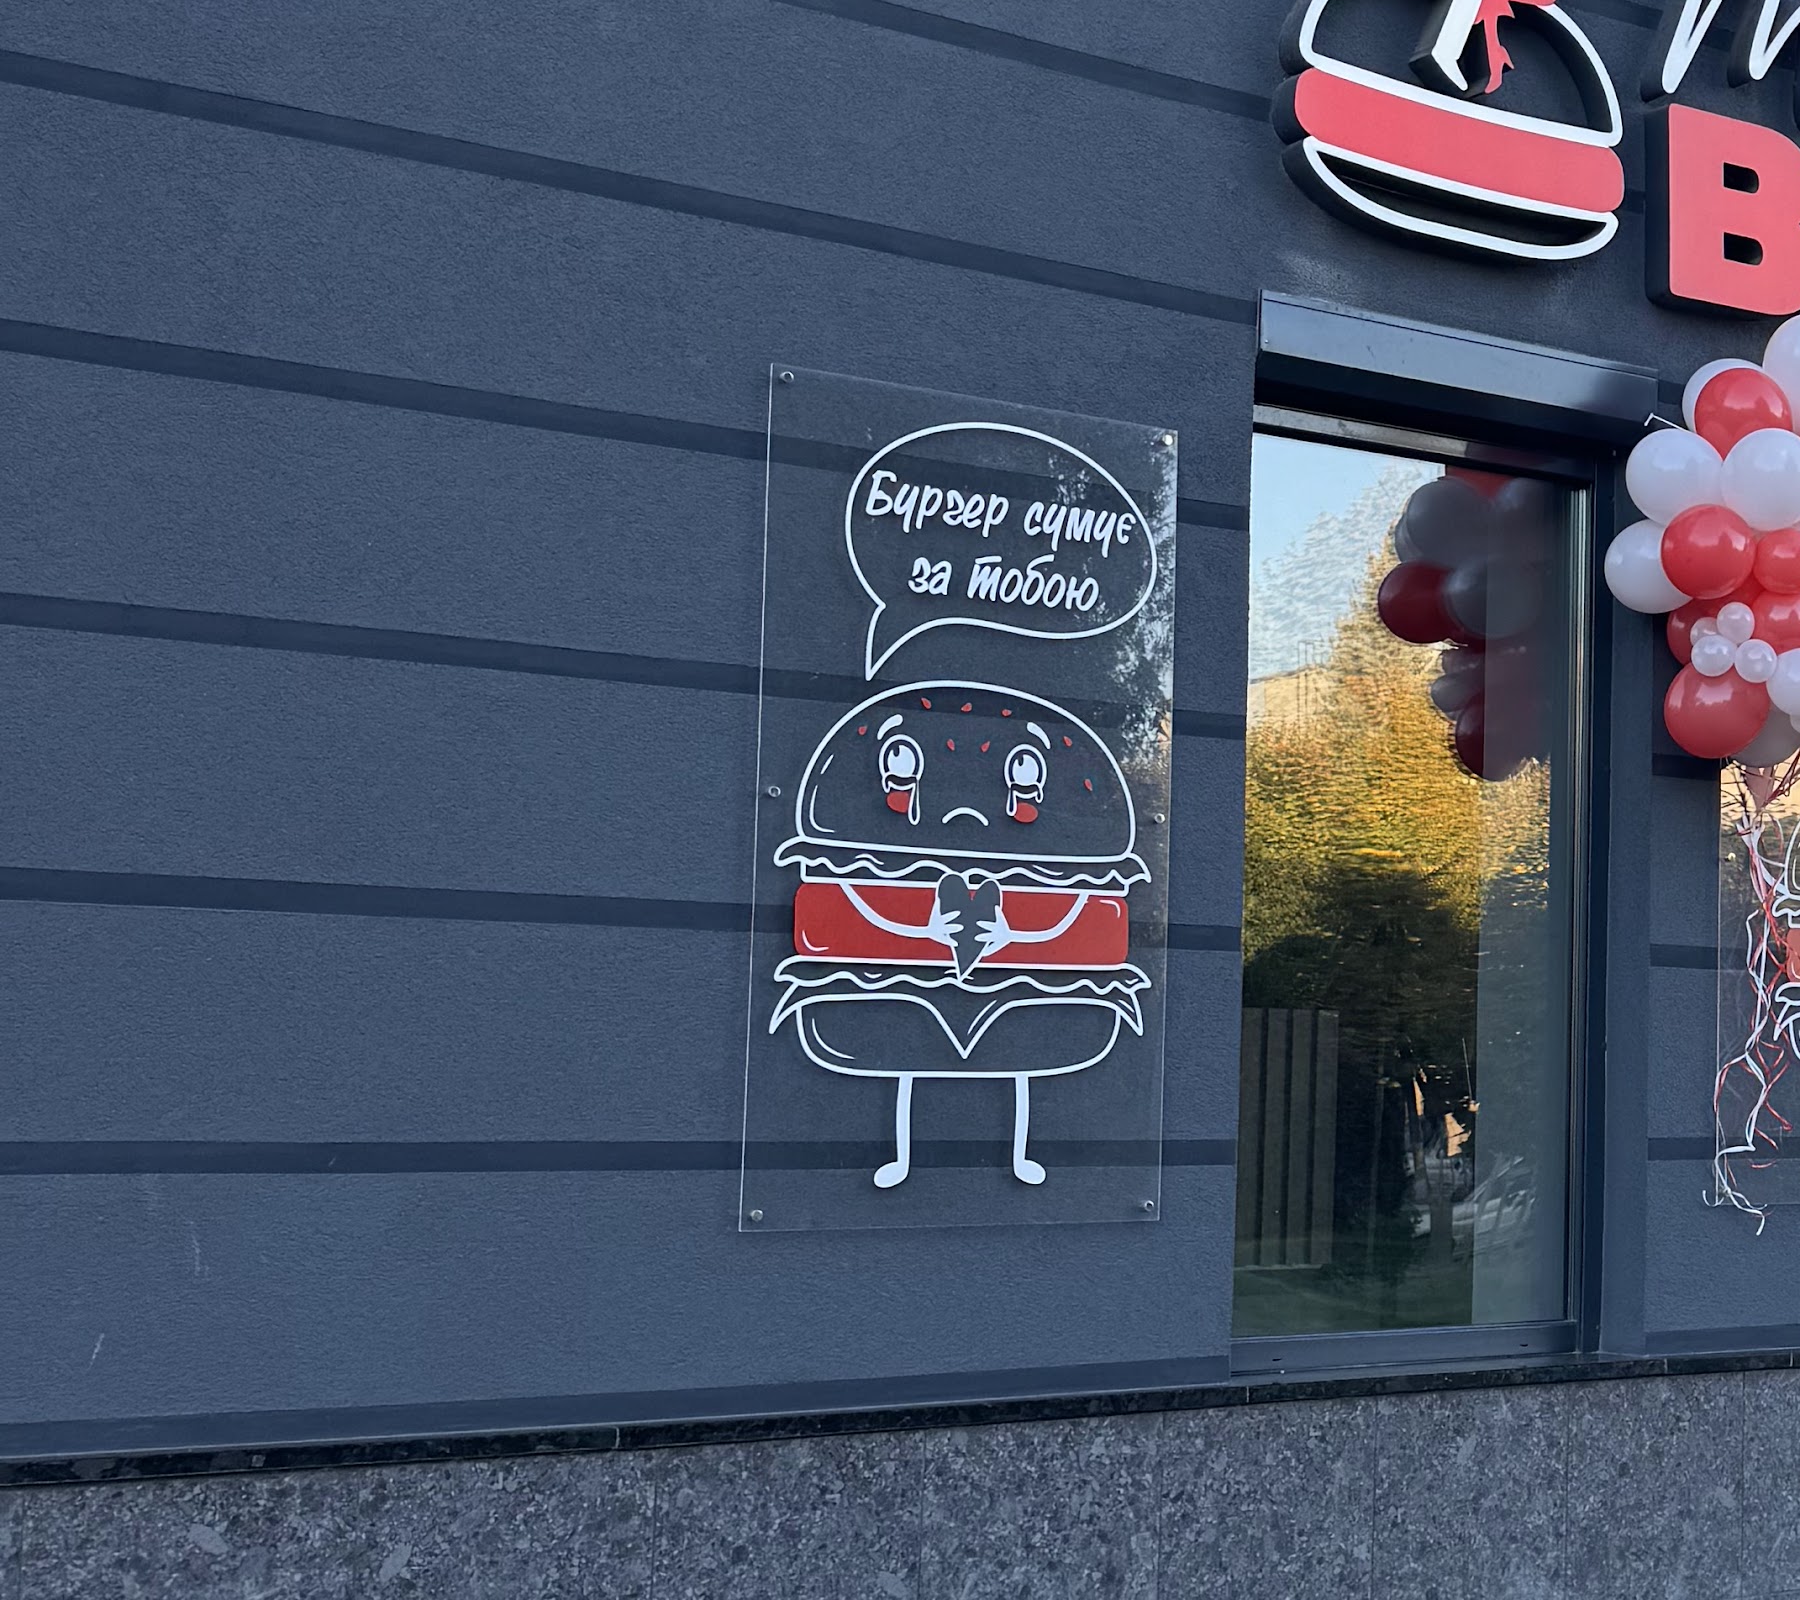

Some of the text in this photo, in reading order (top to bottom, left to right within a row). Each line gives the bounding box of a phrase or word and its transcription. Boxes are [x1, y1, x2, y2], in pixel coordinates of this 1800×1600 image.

[866, 471, 1136, 557] Бургер сумує
[908, 555, 1099, 611] за тобою
